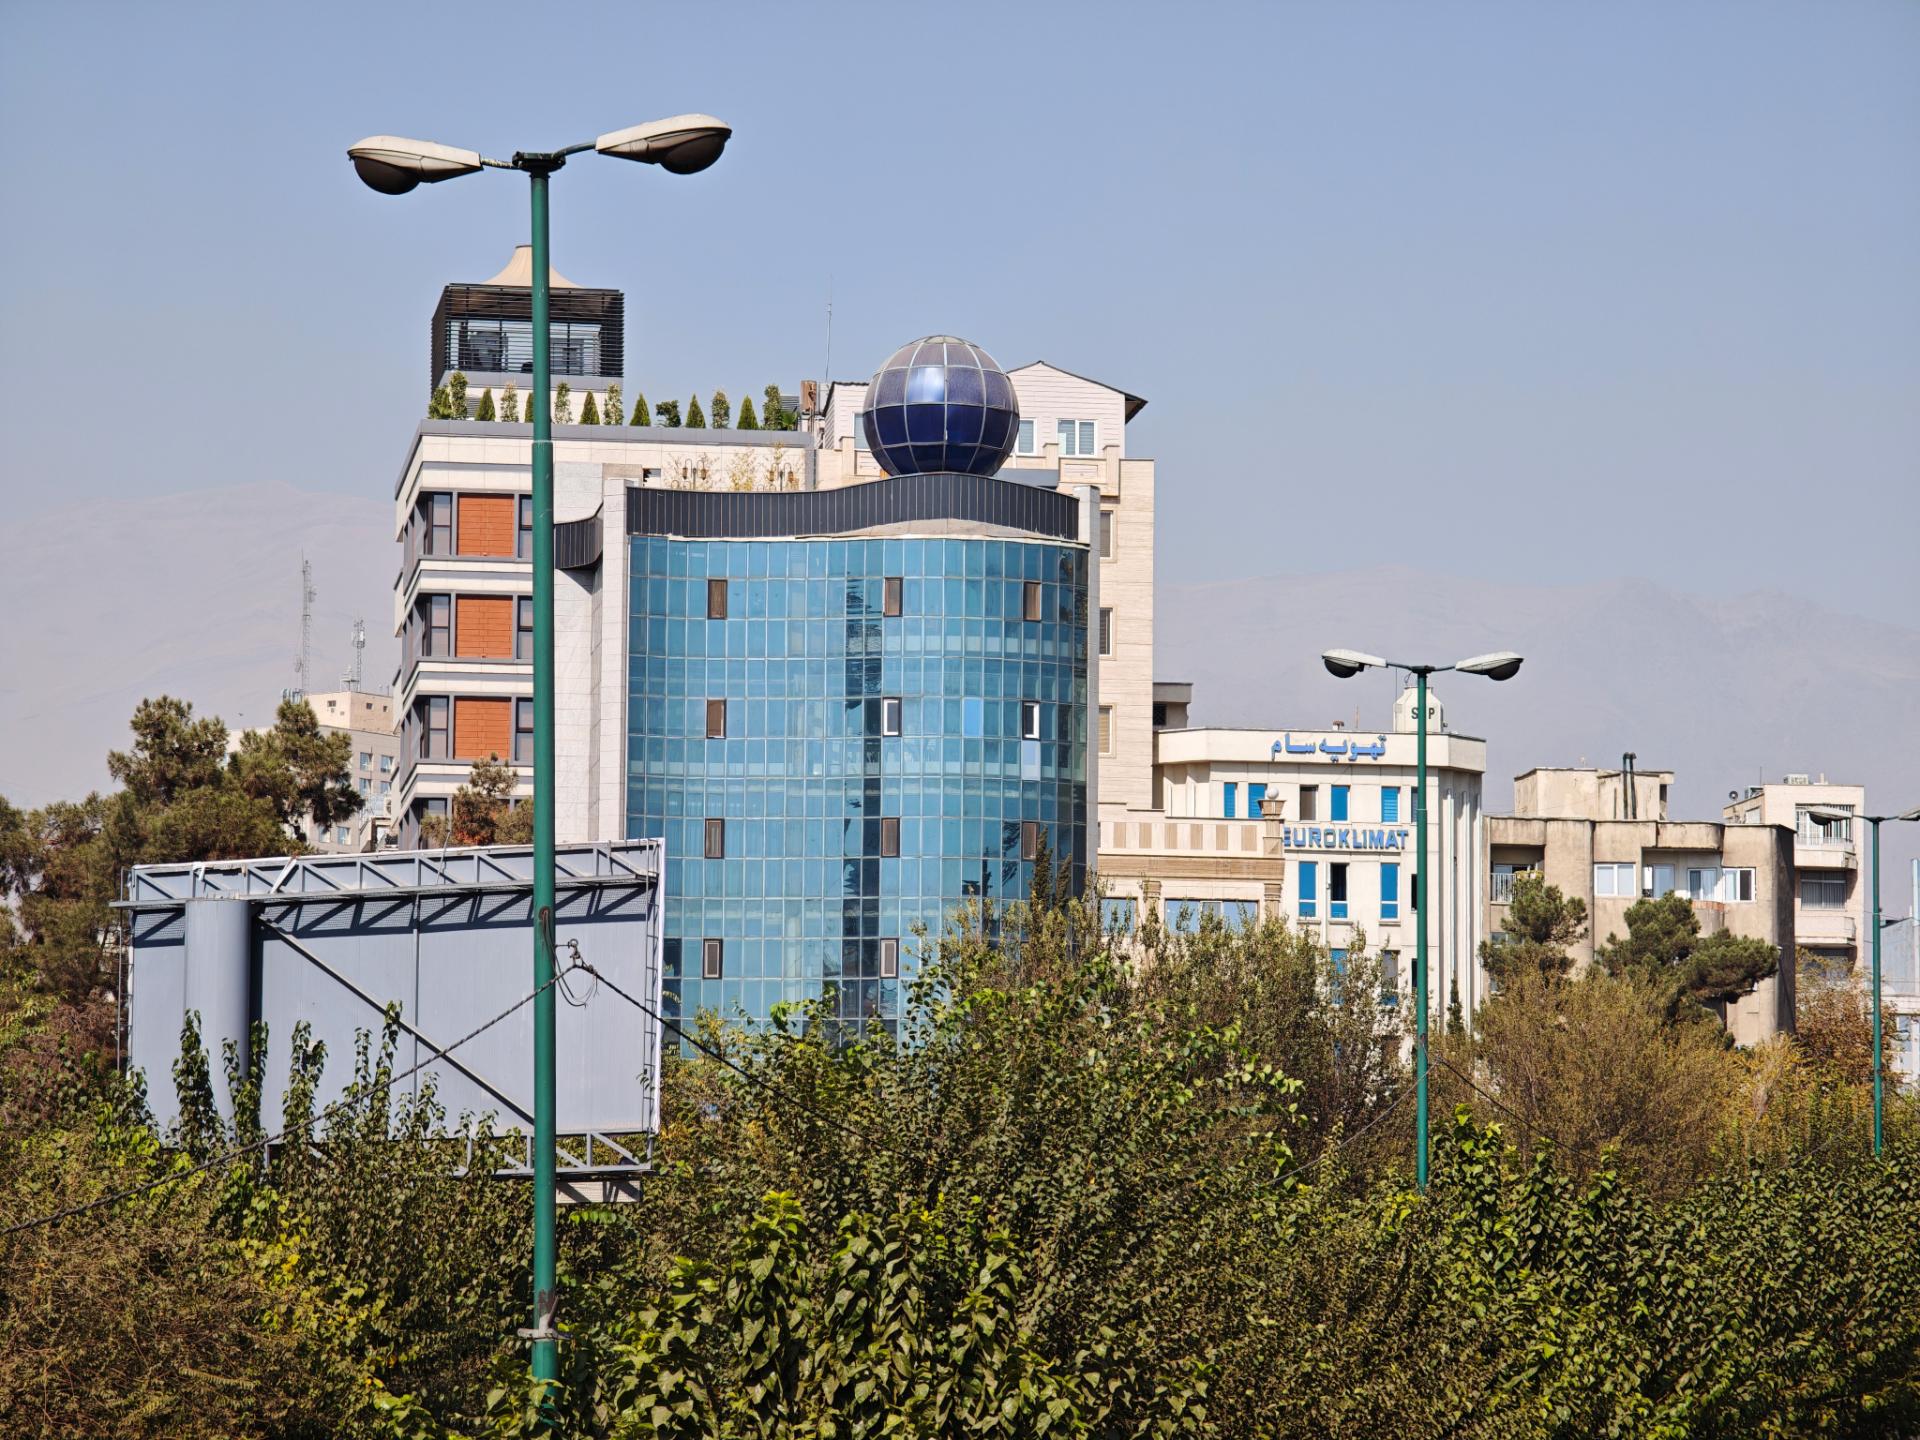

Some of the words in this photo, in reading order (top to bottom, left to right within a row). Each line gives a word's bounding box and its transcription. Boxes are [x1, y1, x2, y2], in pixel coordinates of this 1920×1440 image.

[1411, 707, 1435, 720] SP
[1271, 732, 1317, 762] سام
[1318, 734, 1388, 764] تهویه
[1283, 826, 1409, 850] EUROKLIMAT
